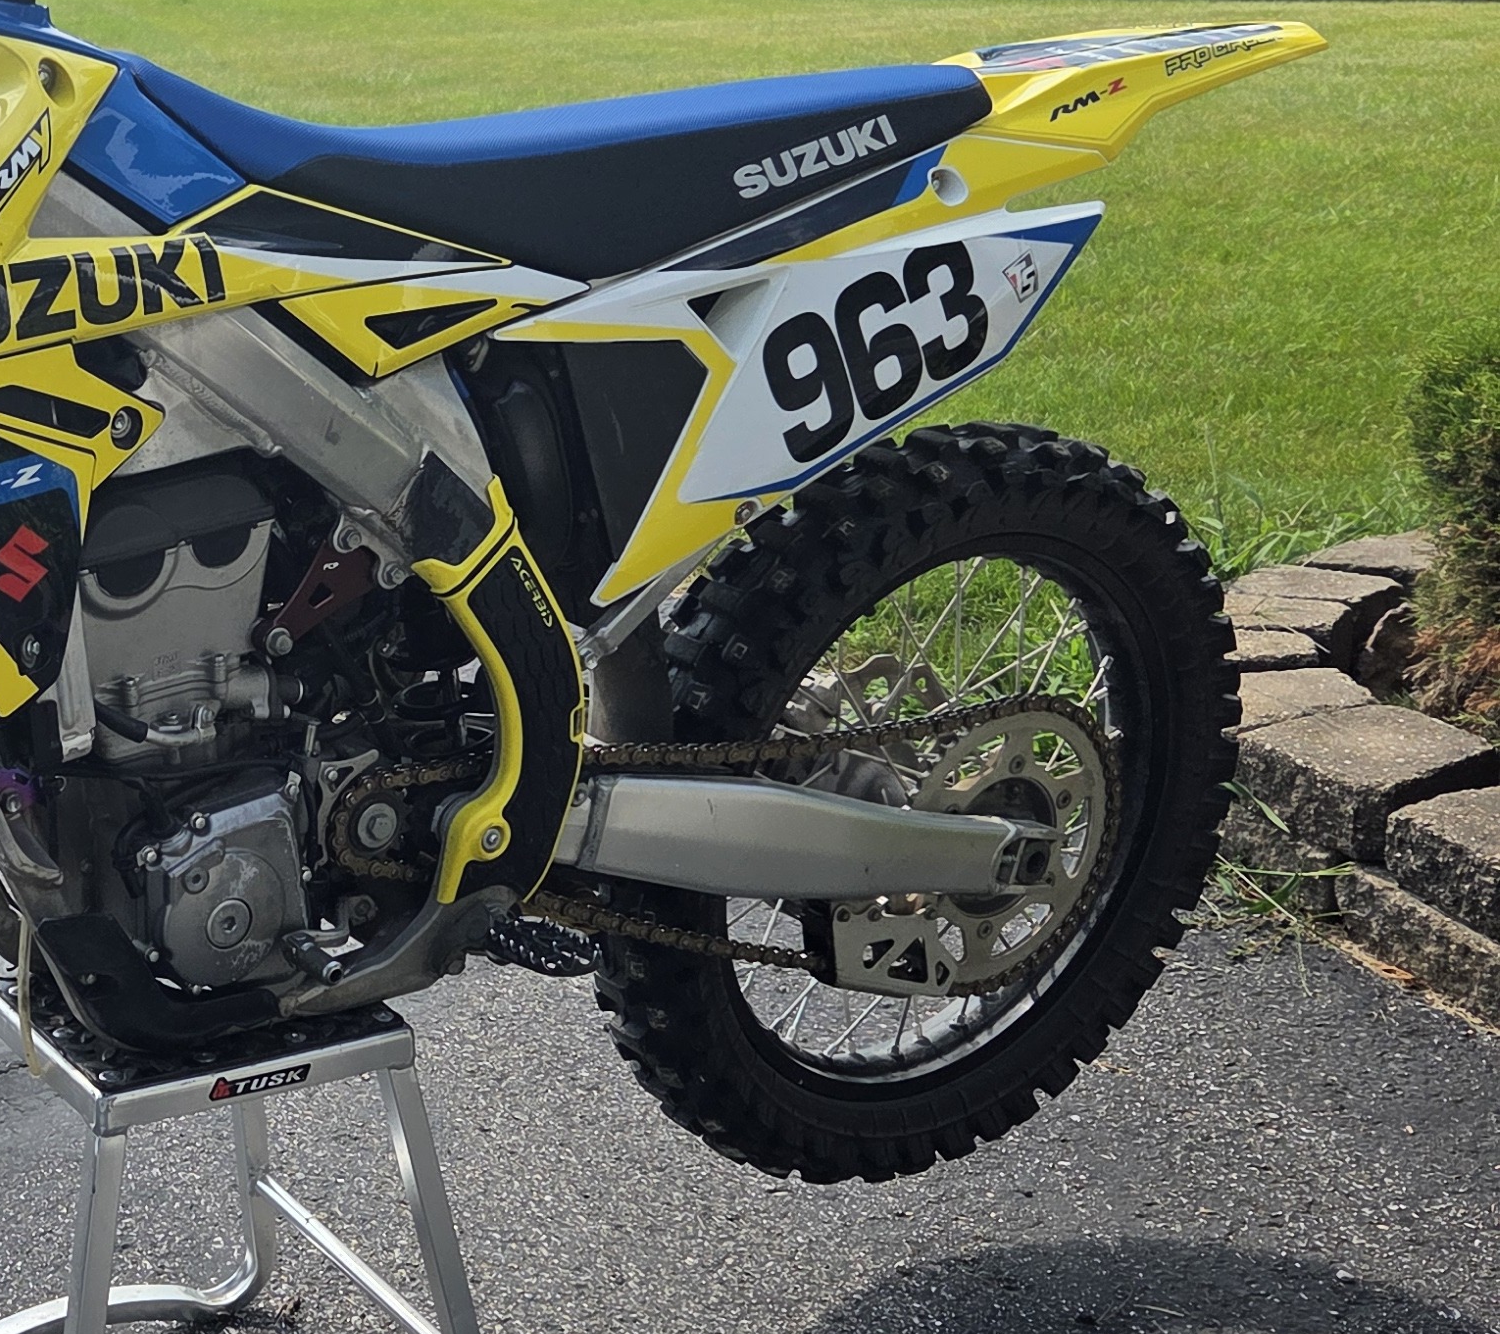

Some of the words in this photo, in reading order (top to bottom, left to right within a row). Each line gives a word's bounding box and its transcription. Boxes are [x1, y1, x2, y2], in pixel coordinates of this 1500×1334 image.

[1164, 44, 1211, 77] PRO
[1049, 77, 1127, 122] RM-Z
[733, 114, 897, 199] SUZUKI
[762, 239, 989, 464] 963
[235, 1068, 304, 1094] TUSK
